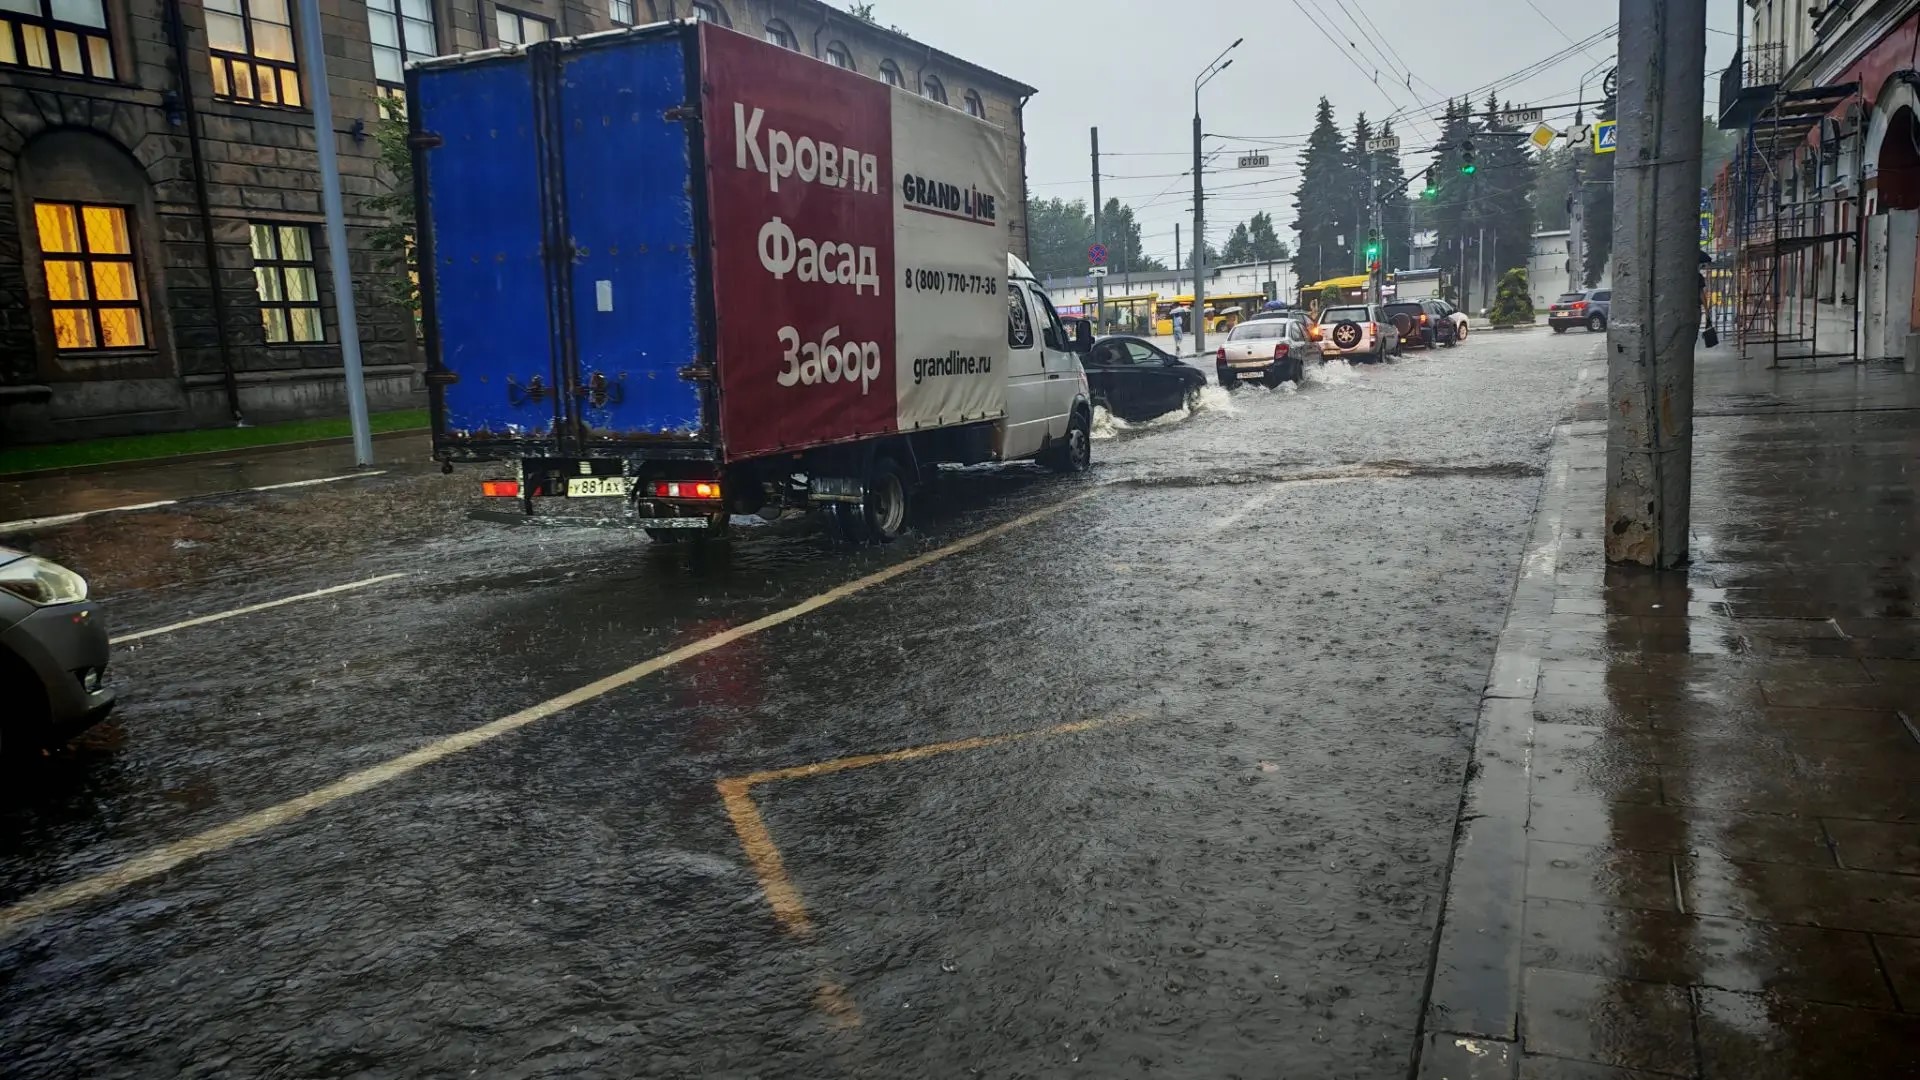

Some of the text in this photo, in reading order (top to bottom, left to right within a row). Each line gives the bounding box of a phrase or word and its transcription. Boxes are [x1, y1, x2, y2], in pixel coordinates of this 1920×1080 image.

[1507, 111, 1537, 123] СТОП
[733, 102, 879, 195] Кровля
[1368, 138, 1395, 149] СТОП
[1240, 157, 1265, 167] СТОП
[902, 173, 996, 220] GRAND LINE
[757, 216, 880, 296] Фасад
[905, 268, 997, 296] 8 (800) 770-77-36
[776, 325, 881, 396] Забор
[913, 351, 992, 385] grandline.ru
